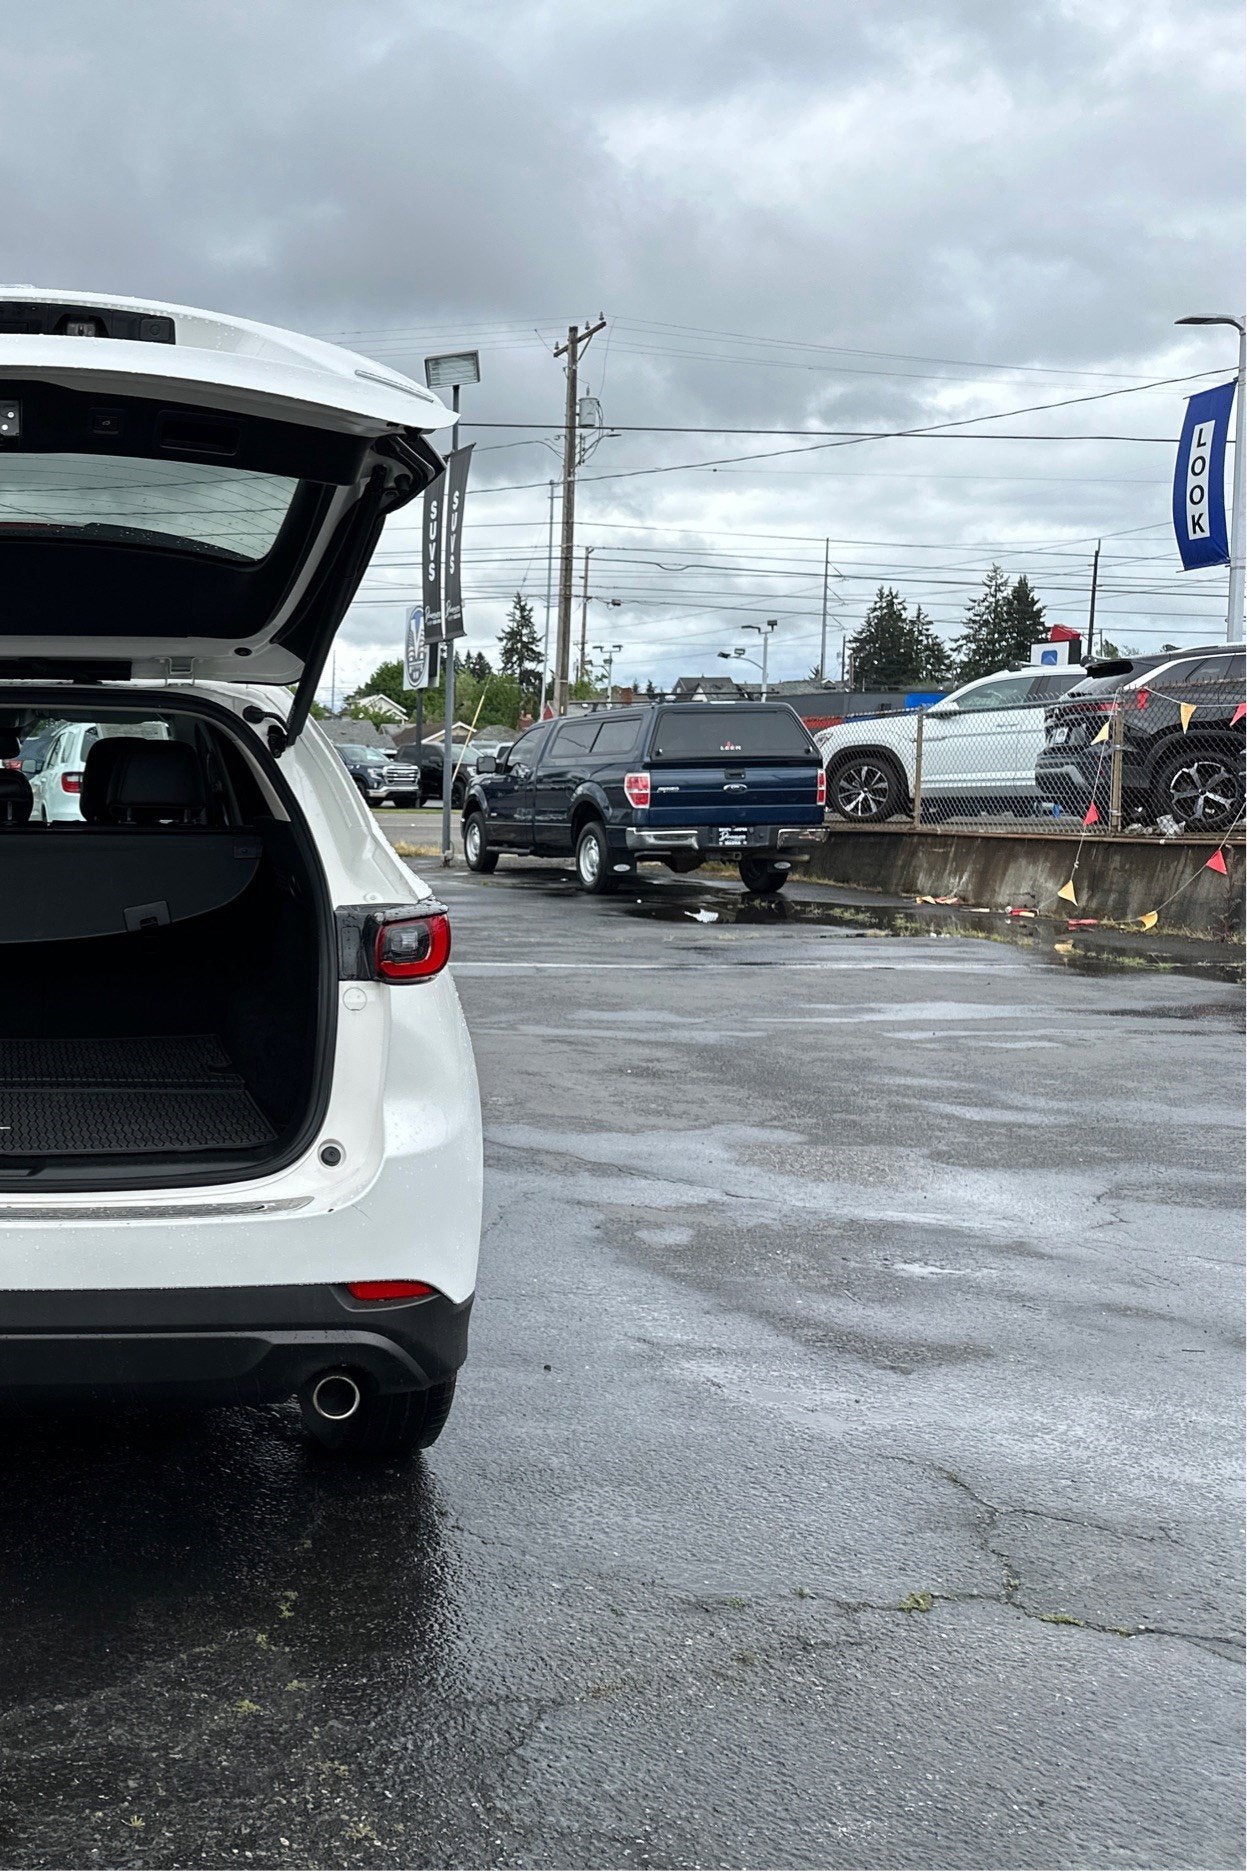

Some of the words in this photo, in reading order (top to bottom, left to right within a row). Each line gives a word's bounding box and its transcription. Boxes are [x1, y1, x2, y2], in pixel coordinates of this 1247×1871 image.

[1189, 427, 1207, 535] LOOK
[428, 500, 438, 582] SUVS
[449, 490, 460, 575] SUVS
